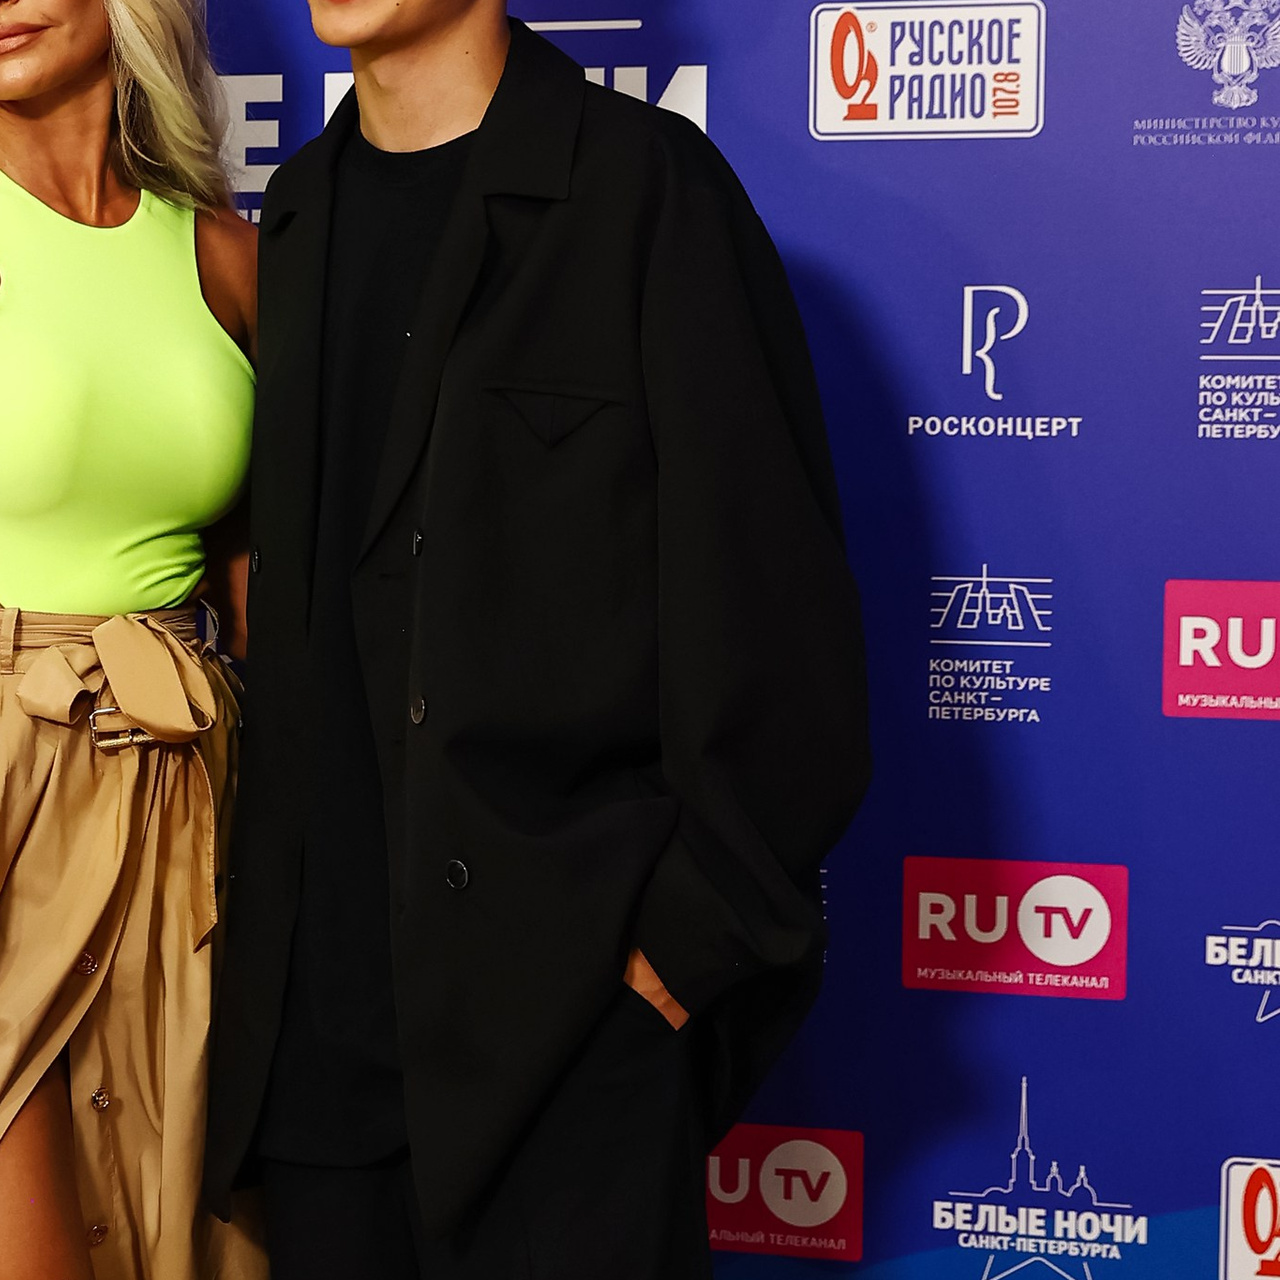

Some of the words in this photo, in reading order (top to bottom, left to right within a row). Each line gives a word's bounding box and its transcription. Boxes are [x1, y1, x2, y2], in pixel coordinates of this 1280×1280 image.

[889, 18, 1021, 66] РУССКОЕ
[888, 72, 986, 121] РАДИО
[907, 415, 1083, 441] РОСКОНЦЕРТ
[928, 657, 1015, 675] КОМИТЕТ
[928, 673, 956, 689] ПО
[959, 674, 1052, 692] КУЛЬТУРЕ
[927, 705, 1041, 723] ПЕТЕРБУРГА
[916, 965, 1024, 984] МУЗЫКАЛЬНЫЙ
[1027, 971, 1110, 989] ТЕЛЕКАНАЛ
[932, 1198, 1047, 1238] БЕЛЫЕ
[1054, 1208, 1148, 1246] НОЧИ
[958, 1231, 1121, 1261] САНКТ-ПЕТЕРБУРГА
